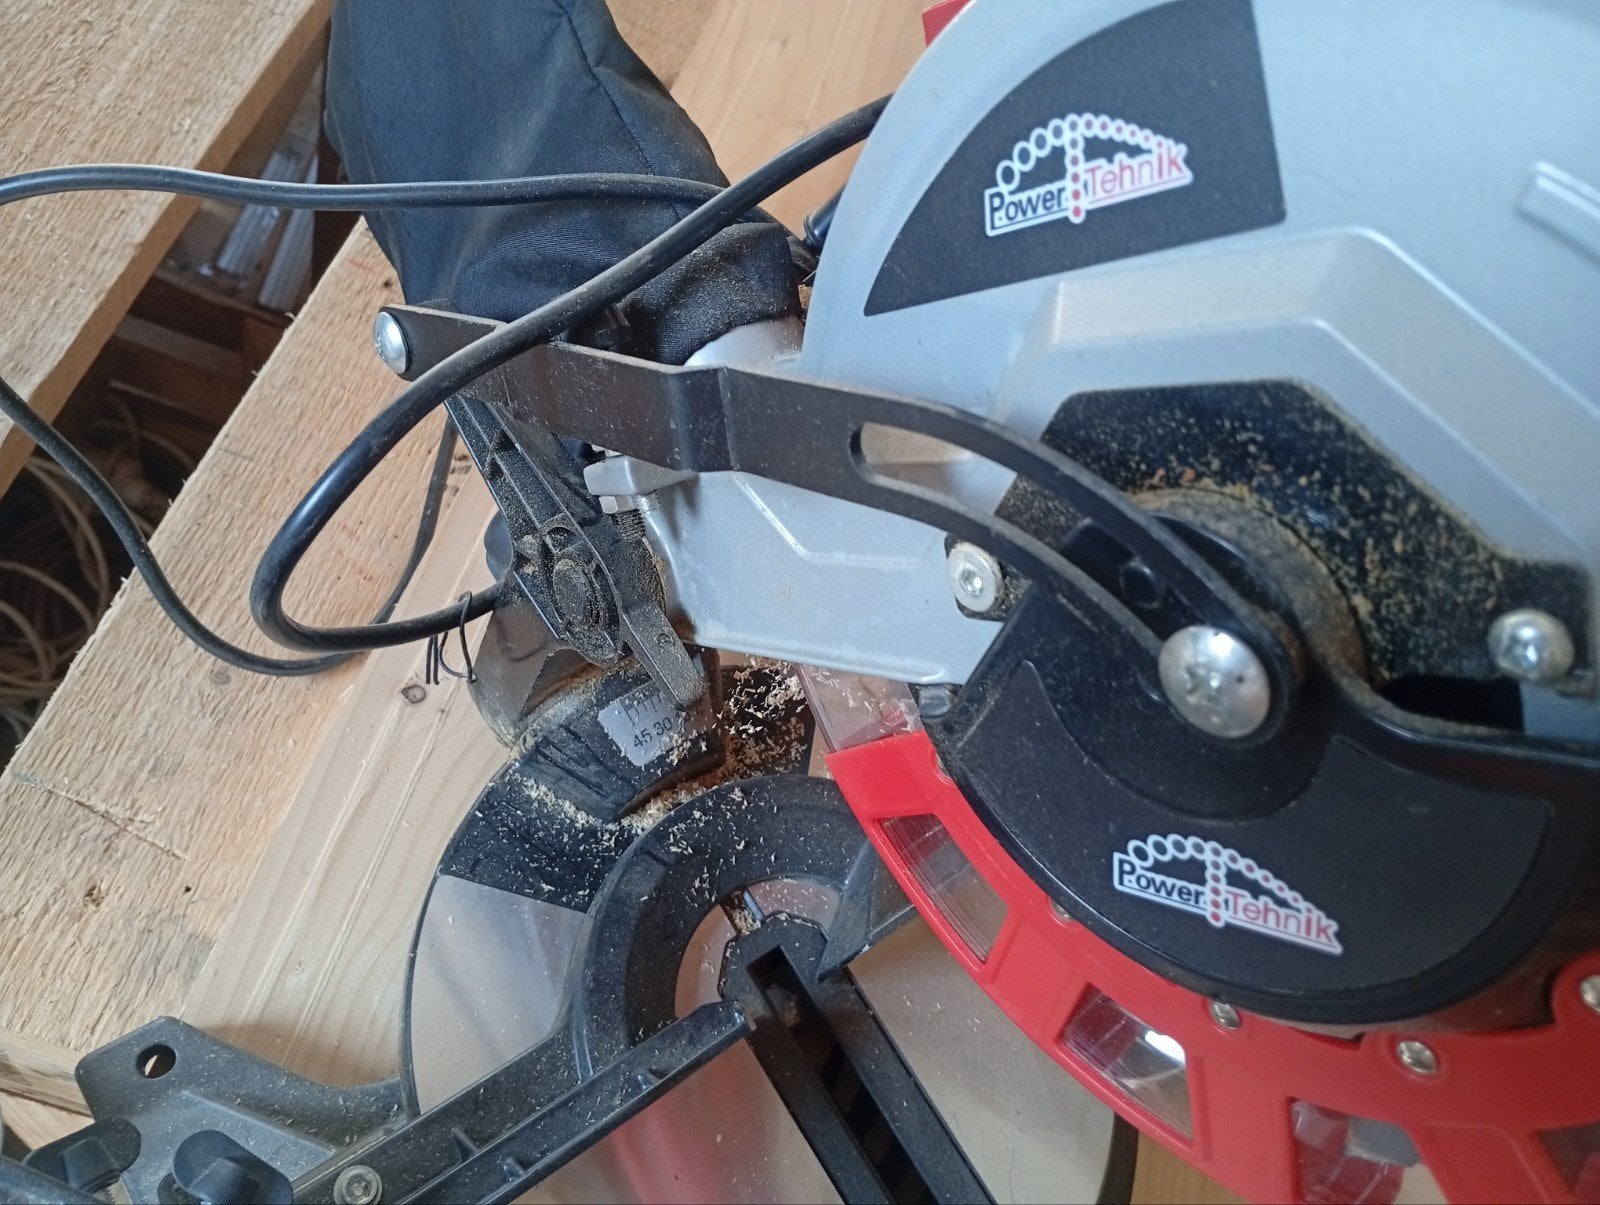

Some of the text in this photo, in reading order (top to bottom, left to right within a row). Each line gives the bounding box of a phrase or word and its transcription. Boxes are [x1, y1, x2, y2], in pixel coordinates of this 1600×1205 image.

[989, 143, 1184, 231] Power Tehnik
[633, 728, 653, 748] 45
[653, 716, 673, 736] 30
[1118, 859, 1334, 944] Power Tehnik
